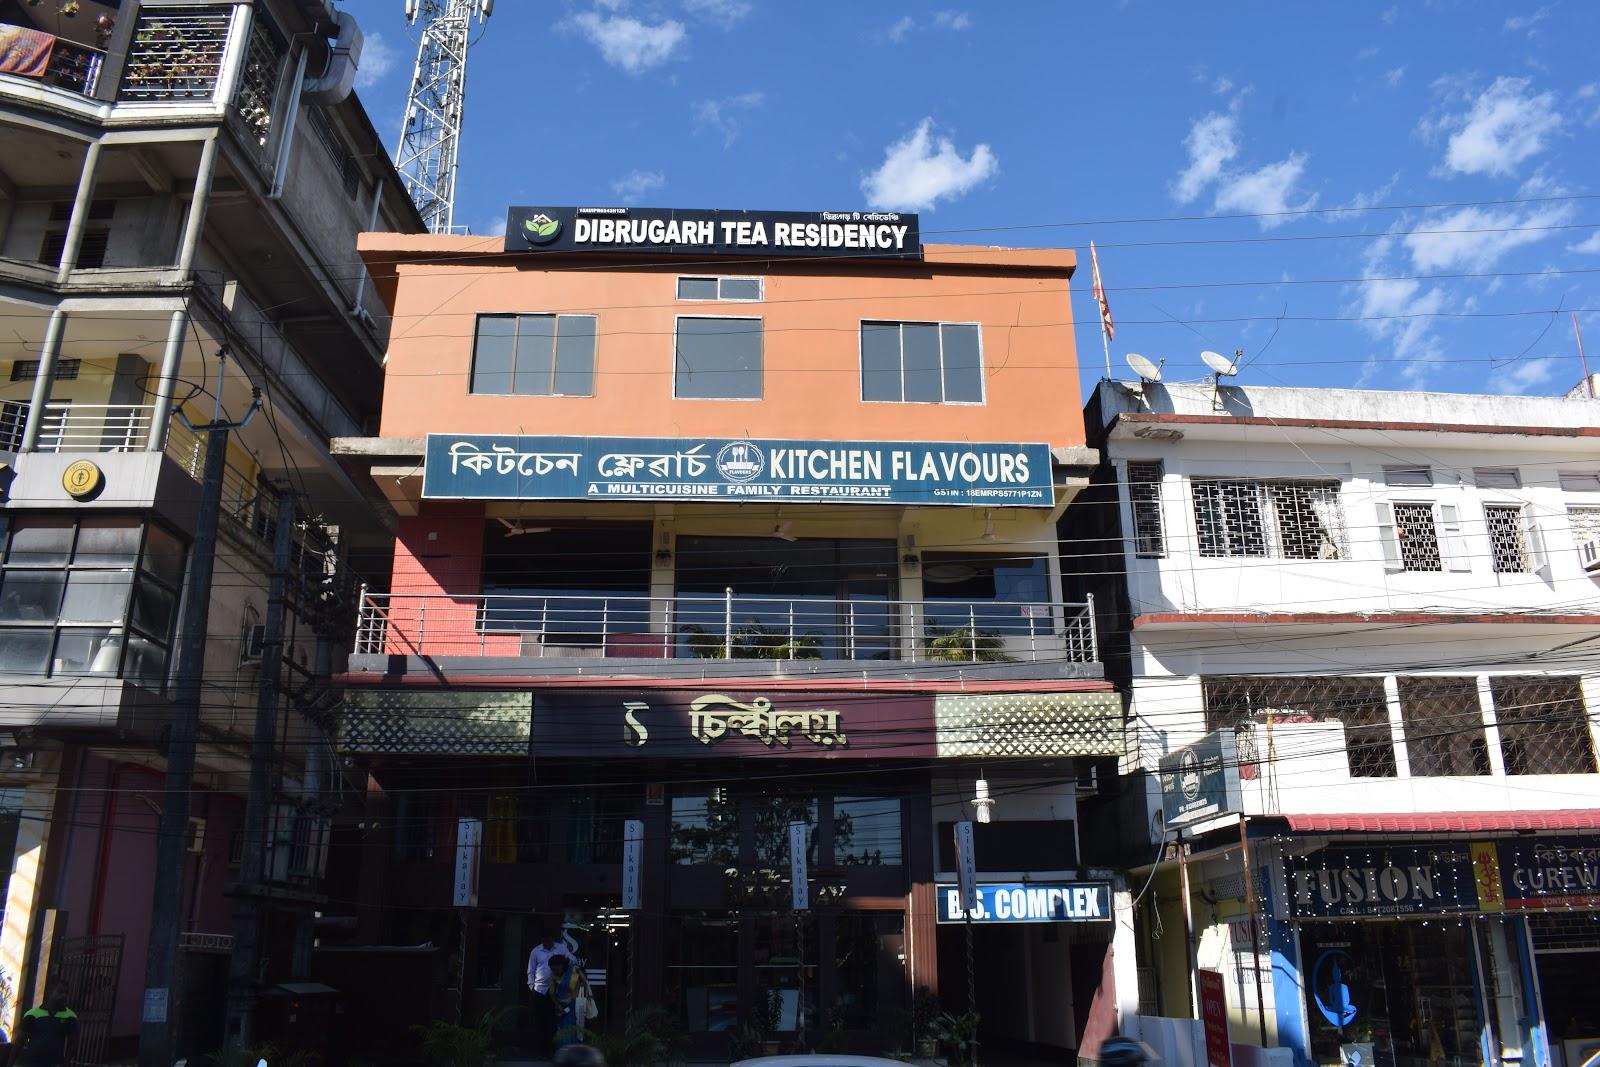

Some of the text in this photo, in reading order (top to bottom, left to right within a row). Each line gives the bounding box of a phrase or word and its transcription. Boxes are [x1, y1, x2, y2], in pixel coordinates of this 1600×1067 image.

[574, 219, 908, 249] DIBRUGARH TEA RESIDENCY
[448, 442, 582, 478] কিটচেন
[770, 449, 1030, 483] KITCHEN FLAVOURS
[588, 483, 892, 497] A MULTICUISINE FAMILY RESTAURANT
[627, 823, 636, 904] Silkalay
[963, 825, 974, 904] Silkalay
[1295, 866, 1435, 905] FUSION
[995, 888, 1101, 919] COMPLEX
